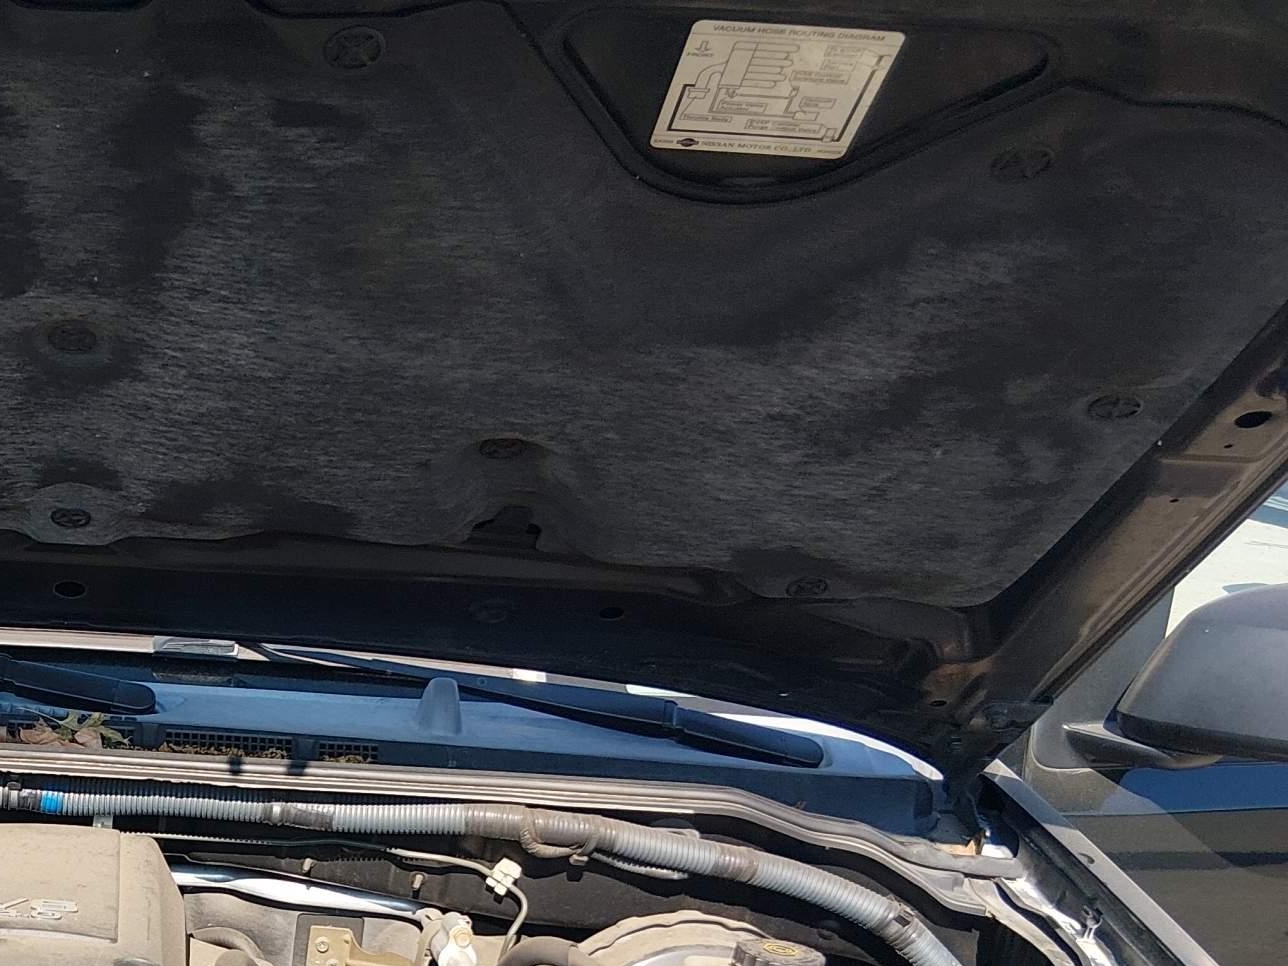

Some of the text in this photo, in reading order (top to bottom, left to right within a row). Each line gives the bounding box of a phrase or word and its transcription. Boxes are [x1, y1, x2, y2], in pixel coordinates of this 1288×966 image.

[713, 25, 886, 41] VACUUM HOSE ROUTING DIAGRAM
[737, 142, 772, 150] MOTOR
